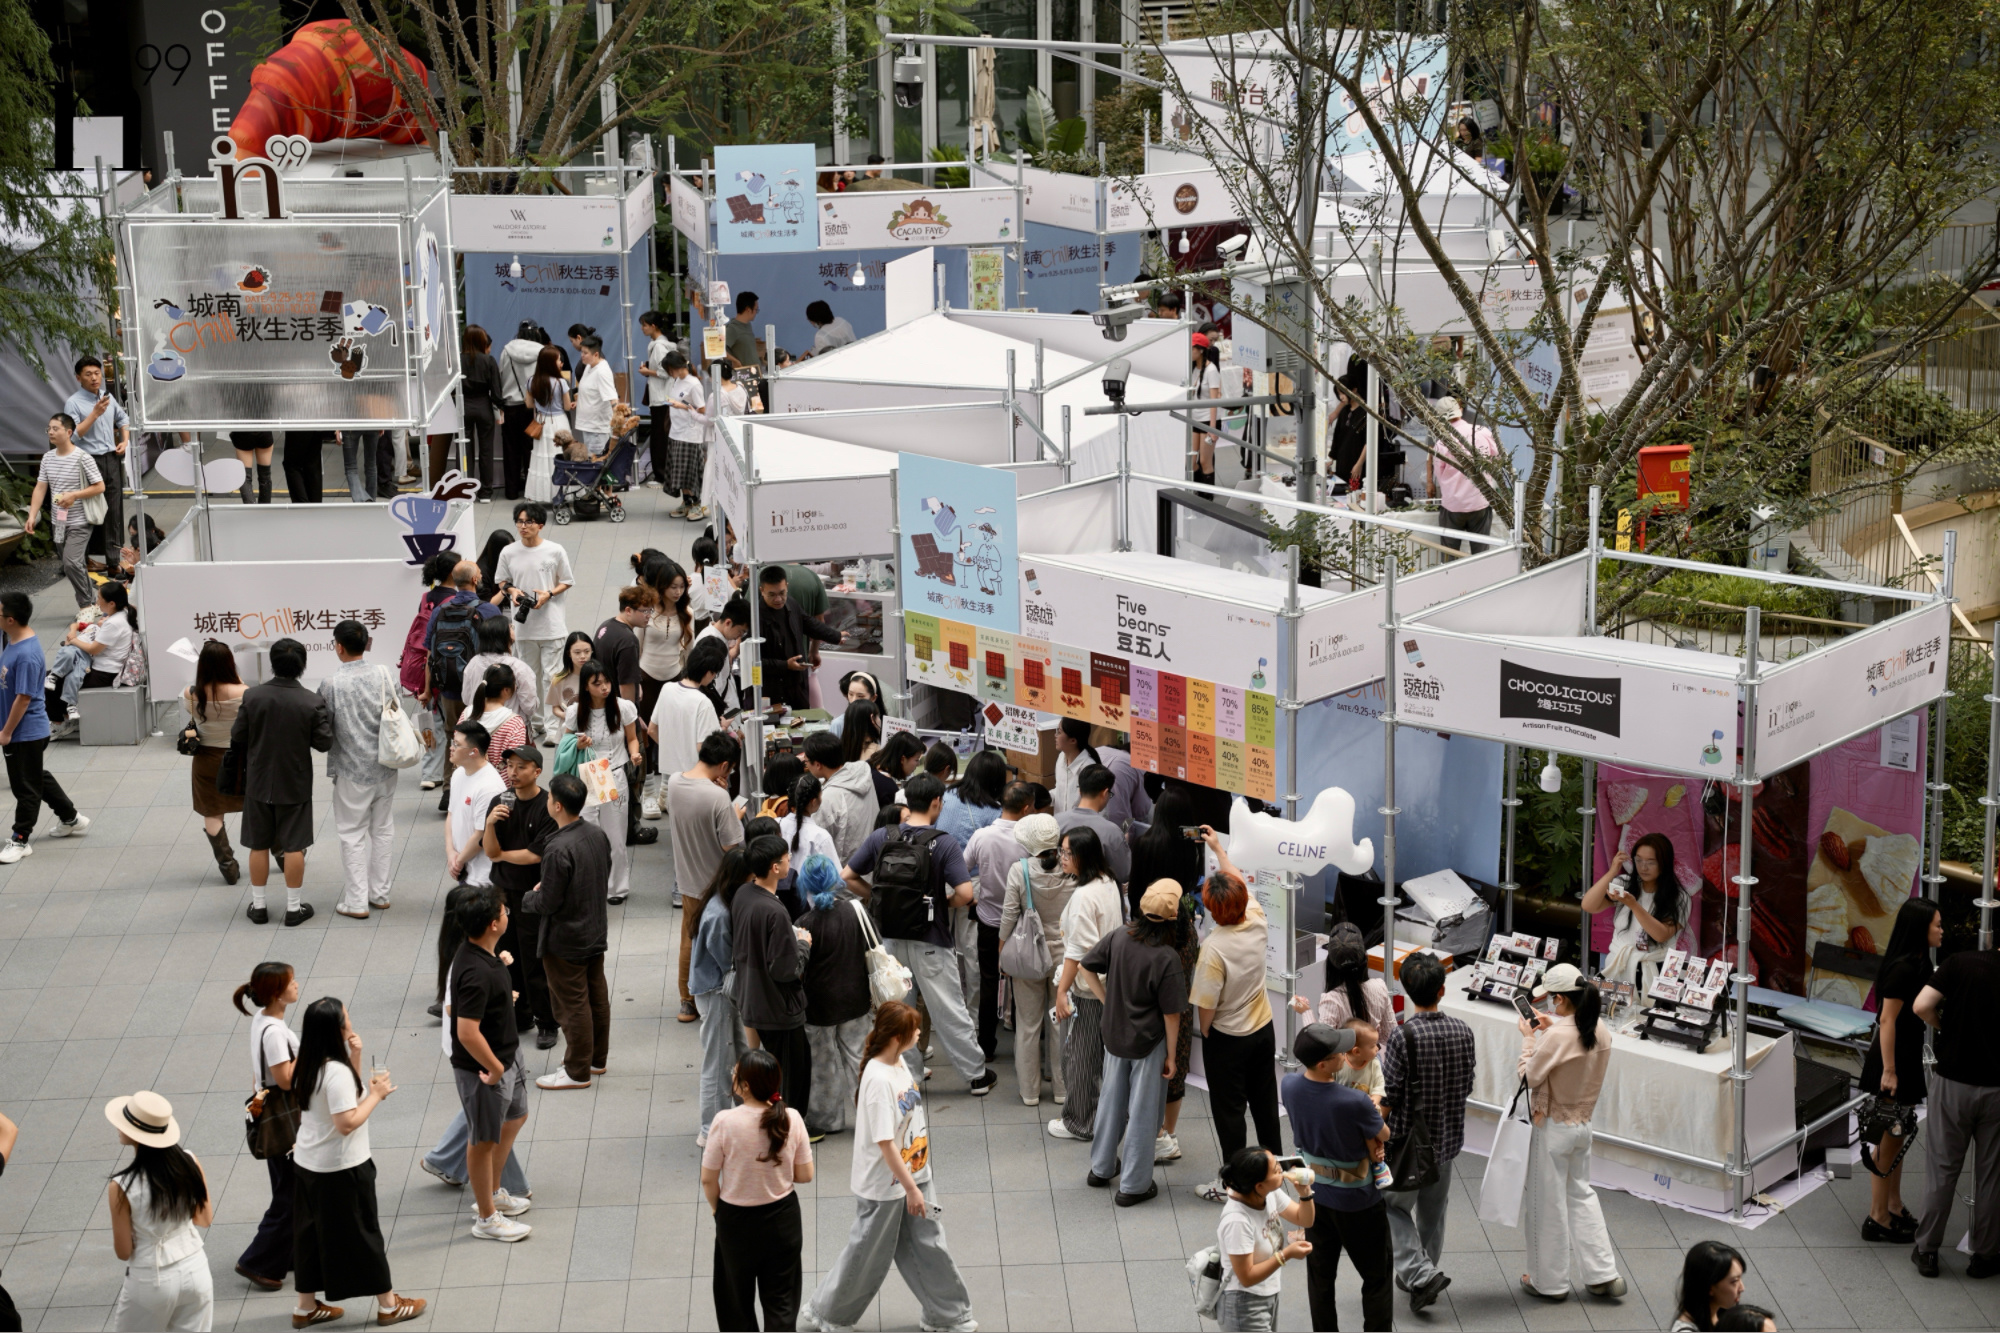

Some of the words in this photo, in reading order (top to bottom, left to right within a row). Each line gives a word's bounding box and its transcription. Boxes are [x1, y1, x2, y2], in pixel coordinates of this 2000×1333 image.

[201, 9, 231, 132] OFFE
[896, 227, 922, 237] CACAO
[925, 226, 944, 235] FAYE
[494, 262, 619, 284] 城Chill秋生活季
[187, 292, 242, 318] 城南
[816, 523, 847, 531] 10.01-10.03
[1116, 594, 1147, 615] Five
[1025, 604, 1053, 621] 巧克力节
[1118, 612, 1171, 637] beans
[1116, 631, 1171, 662] 豆五人
[1136, 679, 1152, 691] 70%
[1164, 685, 1180, 697] 72%
[1403, 678, 1440, 695] 巧克力节
[1193, 691, 1209, 703] 70%
[1404, 688, 1420, 697] BEAN
[1428, 693, 1440, 701] BAR
[1507, 678, 1613, 706] CHOCOLICIOUS
[1221, 697, 1238, 710] 70%
[1251, 704, 1268, 716] 85%
[1005, 706, 1036, 722] 招牌必买
[1136, 730, 1152, 742] 55%
[1547, 723, 1563, 731] Fruit
[1564, 726, 1597, 740] Chocolate
[1164, 737, 1180, 749] 43%
[1192, 743, 1209, 755] 60%
[1221, 751, 1239, 763] 40%
[1251, 758, 1269, 770] 40%
[1277, 841, 1328, 859] CELINE
